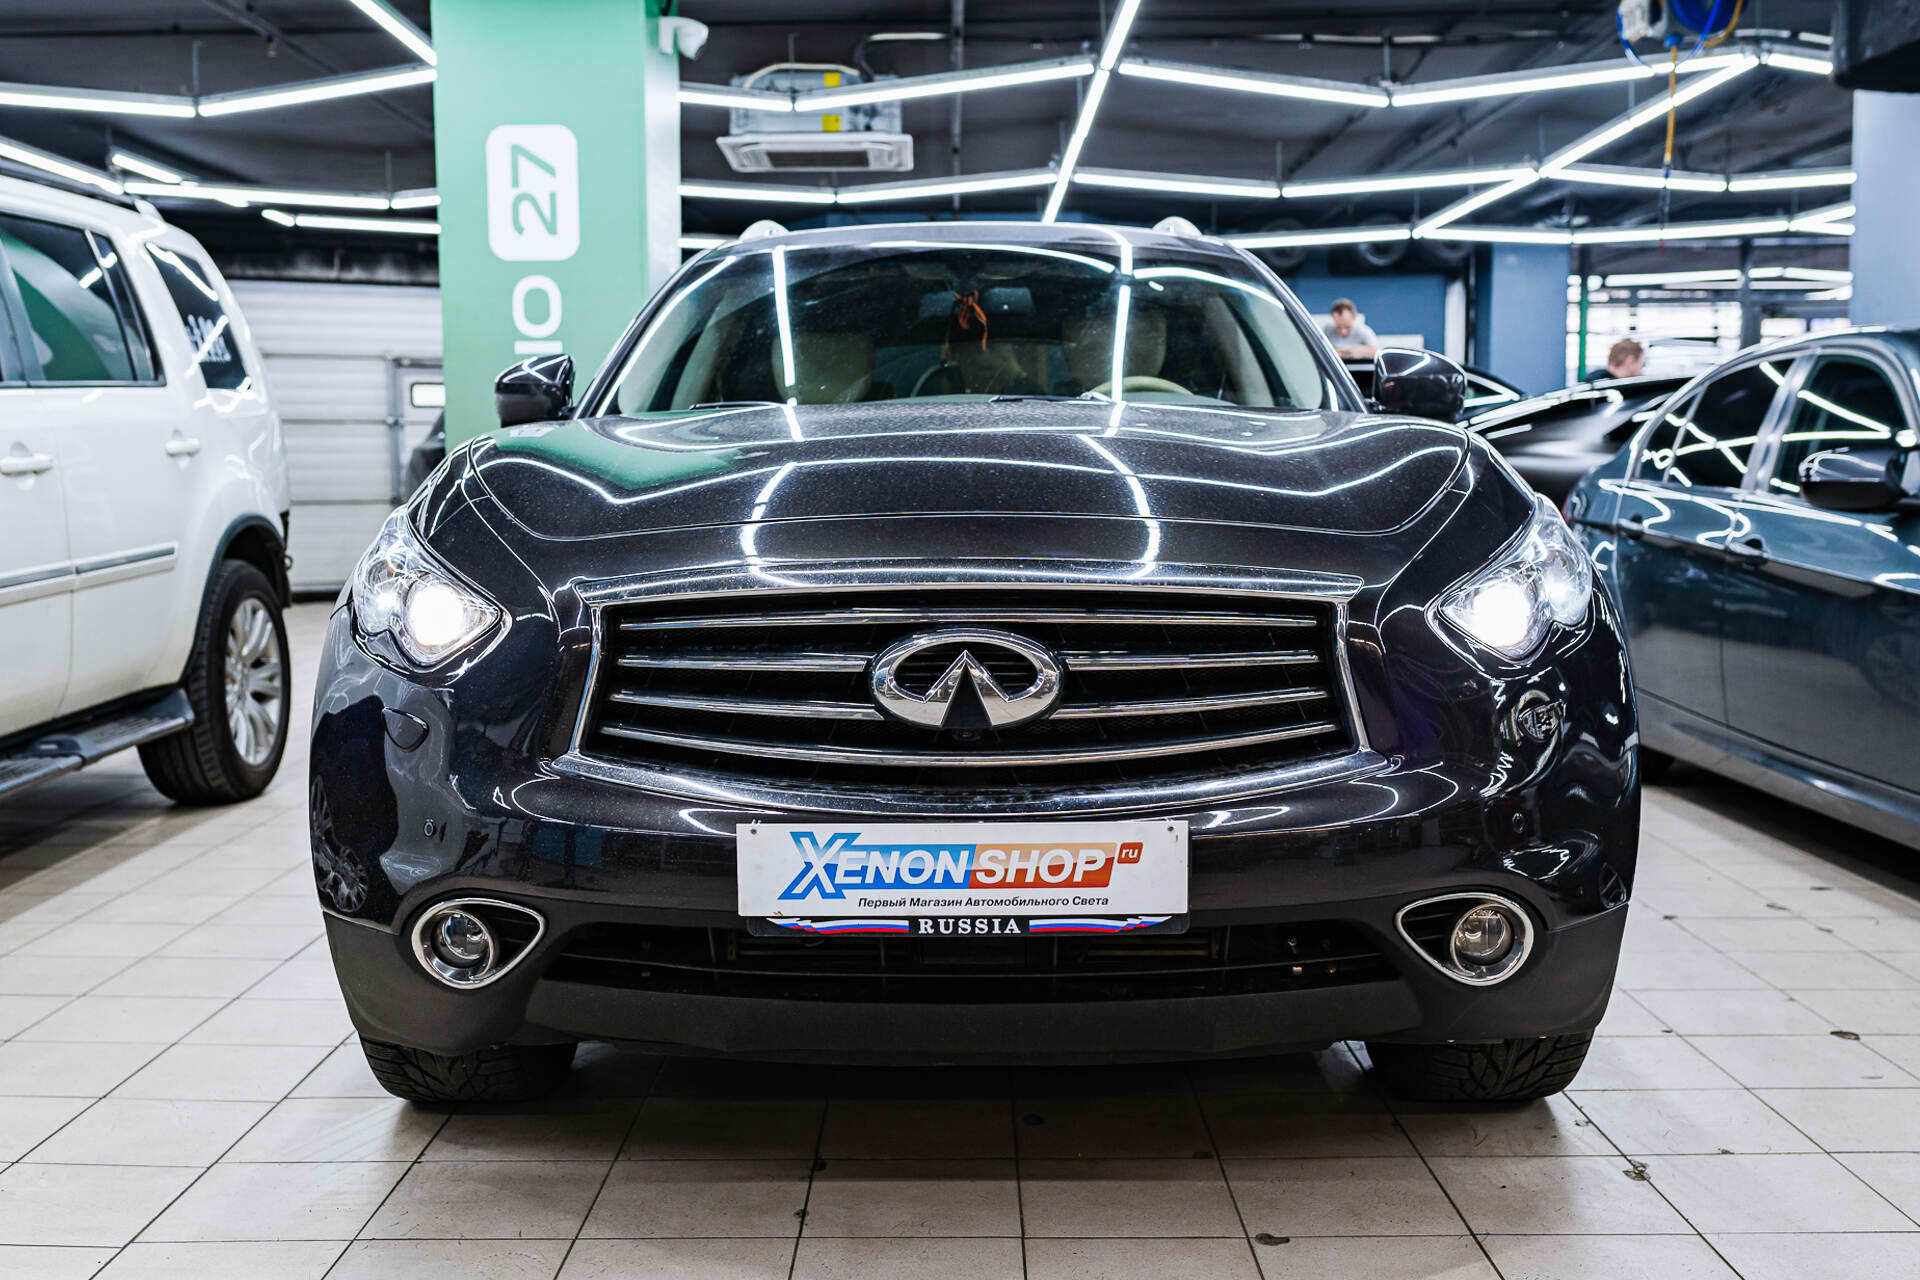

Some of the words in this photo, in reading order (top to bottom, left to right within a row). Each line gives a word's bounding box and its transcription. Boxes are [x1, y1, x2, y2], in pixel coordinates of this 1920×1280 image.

[511, 144, 558, 236] 27
[778, 832, 969, 899] XENON
[975, 849, 1106, 884] SHOP
[1120, 847, 1139, 859] ru
[857, 896, 907, 909] Первый
[909, 896, 964, 908] Магазин
[965, 895, 1069, 908] Автомобильного
[1072, 895, 1109, 907] Света
[918, 917, 1021, 935] RUSSIA
